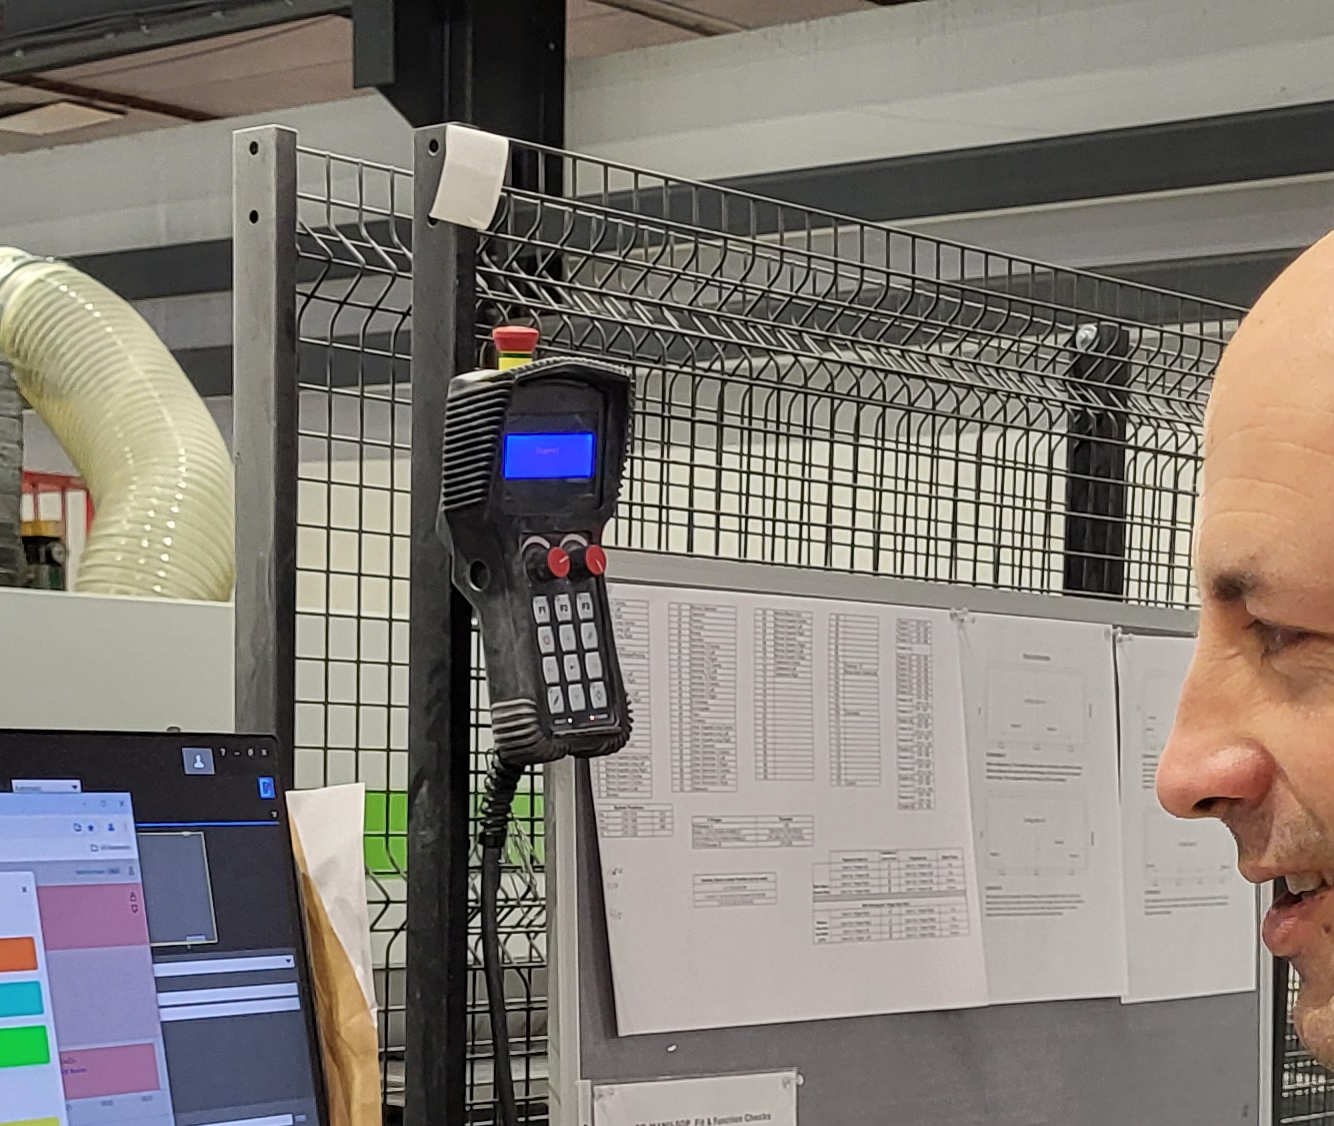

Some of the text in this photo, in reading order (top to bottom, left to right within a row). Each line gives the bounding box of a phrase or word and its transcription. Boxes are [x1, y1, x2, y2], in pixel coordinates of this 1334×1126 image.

[539, 606, 546, 614] F1
[560, 604, 568, 612] F2
[582, 602, 590, 611] F3
[744, 1113, 771, 1123] Checks
